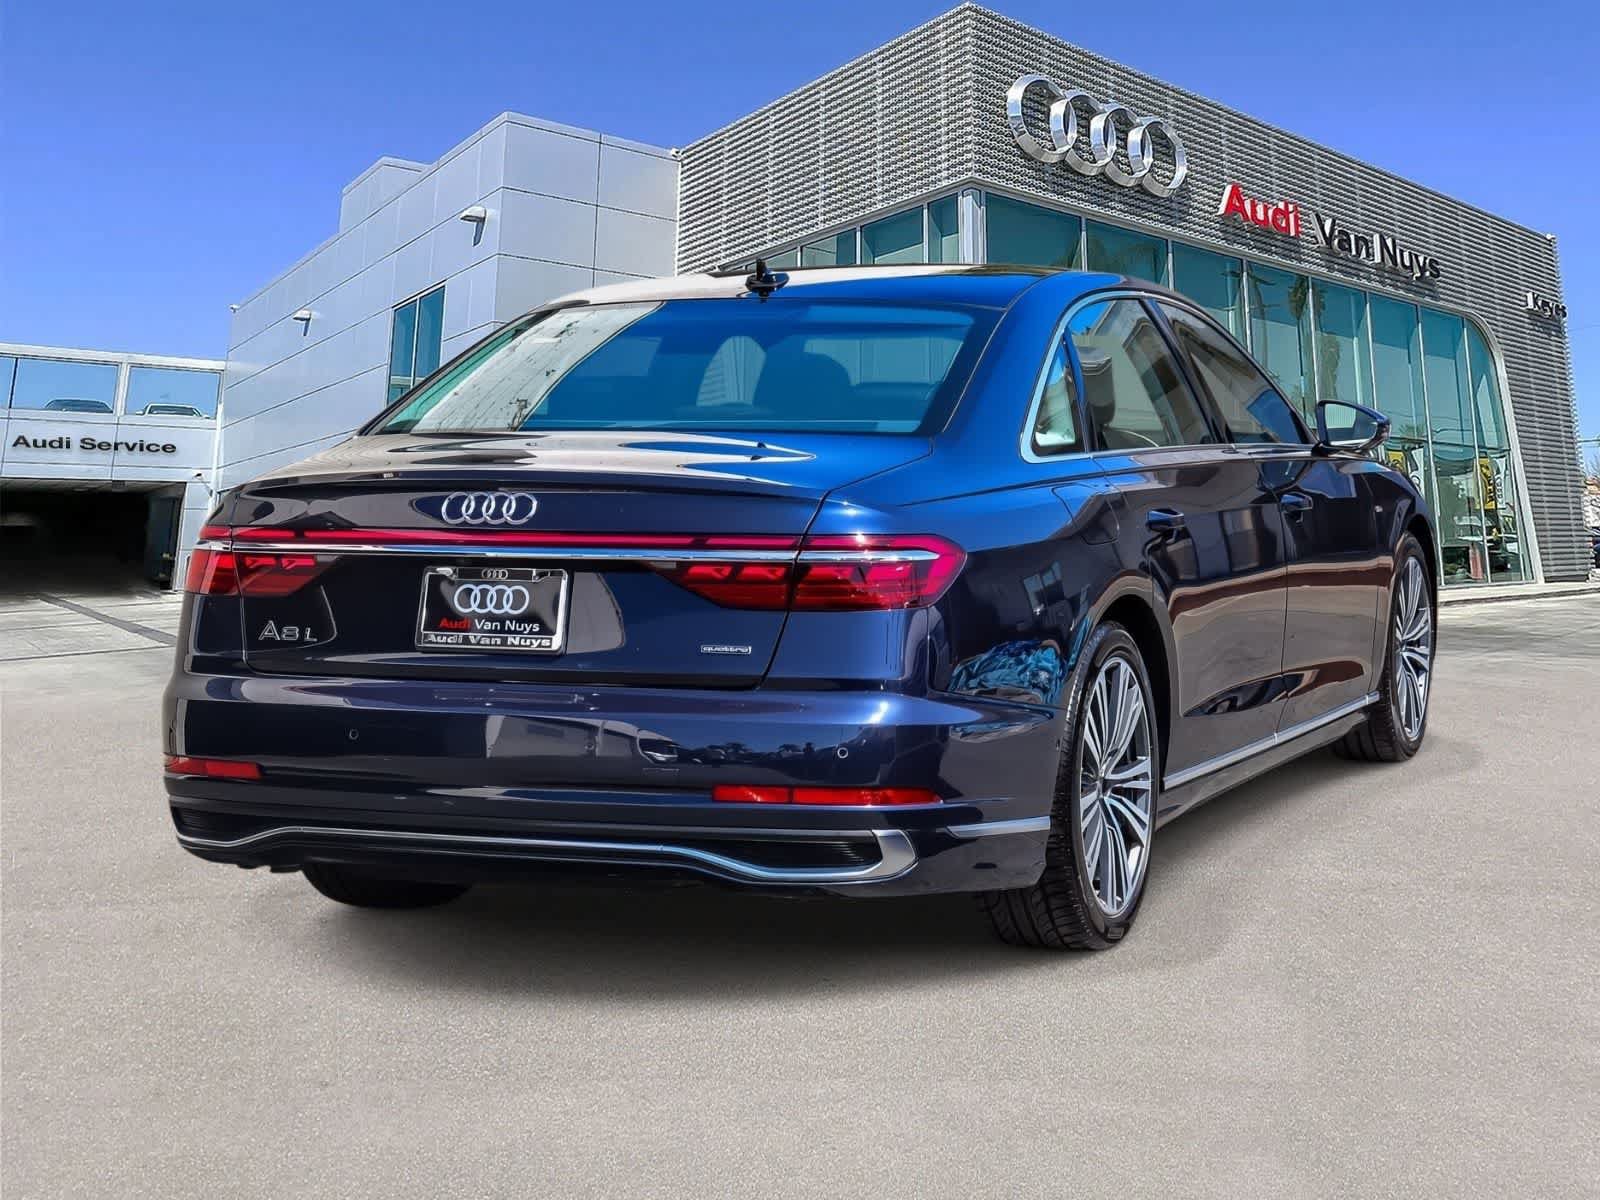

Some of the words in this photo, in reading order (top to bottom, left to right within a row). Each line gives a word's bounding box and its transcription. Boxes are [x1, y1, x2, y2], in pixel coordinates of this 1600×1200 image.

[1218, 182, 1301, 238] Audi
[1312, 212, 1371, 260] Van
[1374, 233, 1441, 281] Nuys
[1526, 292, 1568, 319] Keyes
[12, 434, 71, 449] Audi
[80, 437, 177, 454] Service
[258, 620, 300, 641] A8
[304, 627, 318, 642] L
[439, 616, 471, 630] Audi
[474, 618, 501, 631] Van
[505, 619, 540, 634] Nuys
[425, 633, 464, 644] Audi
[469, 634, 502, 646] Van
[507, 635, 552, 649] Nuys
